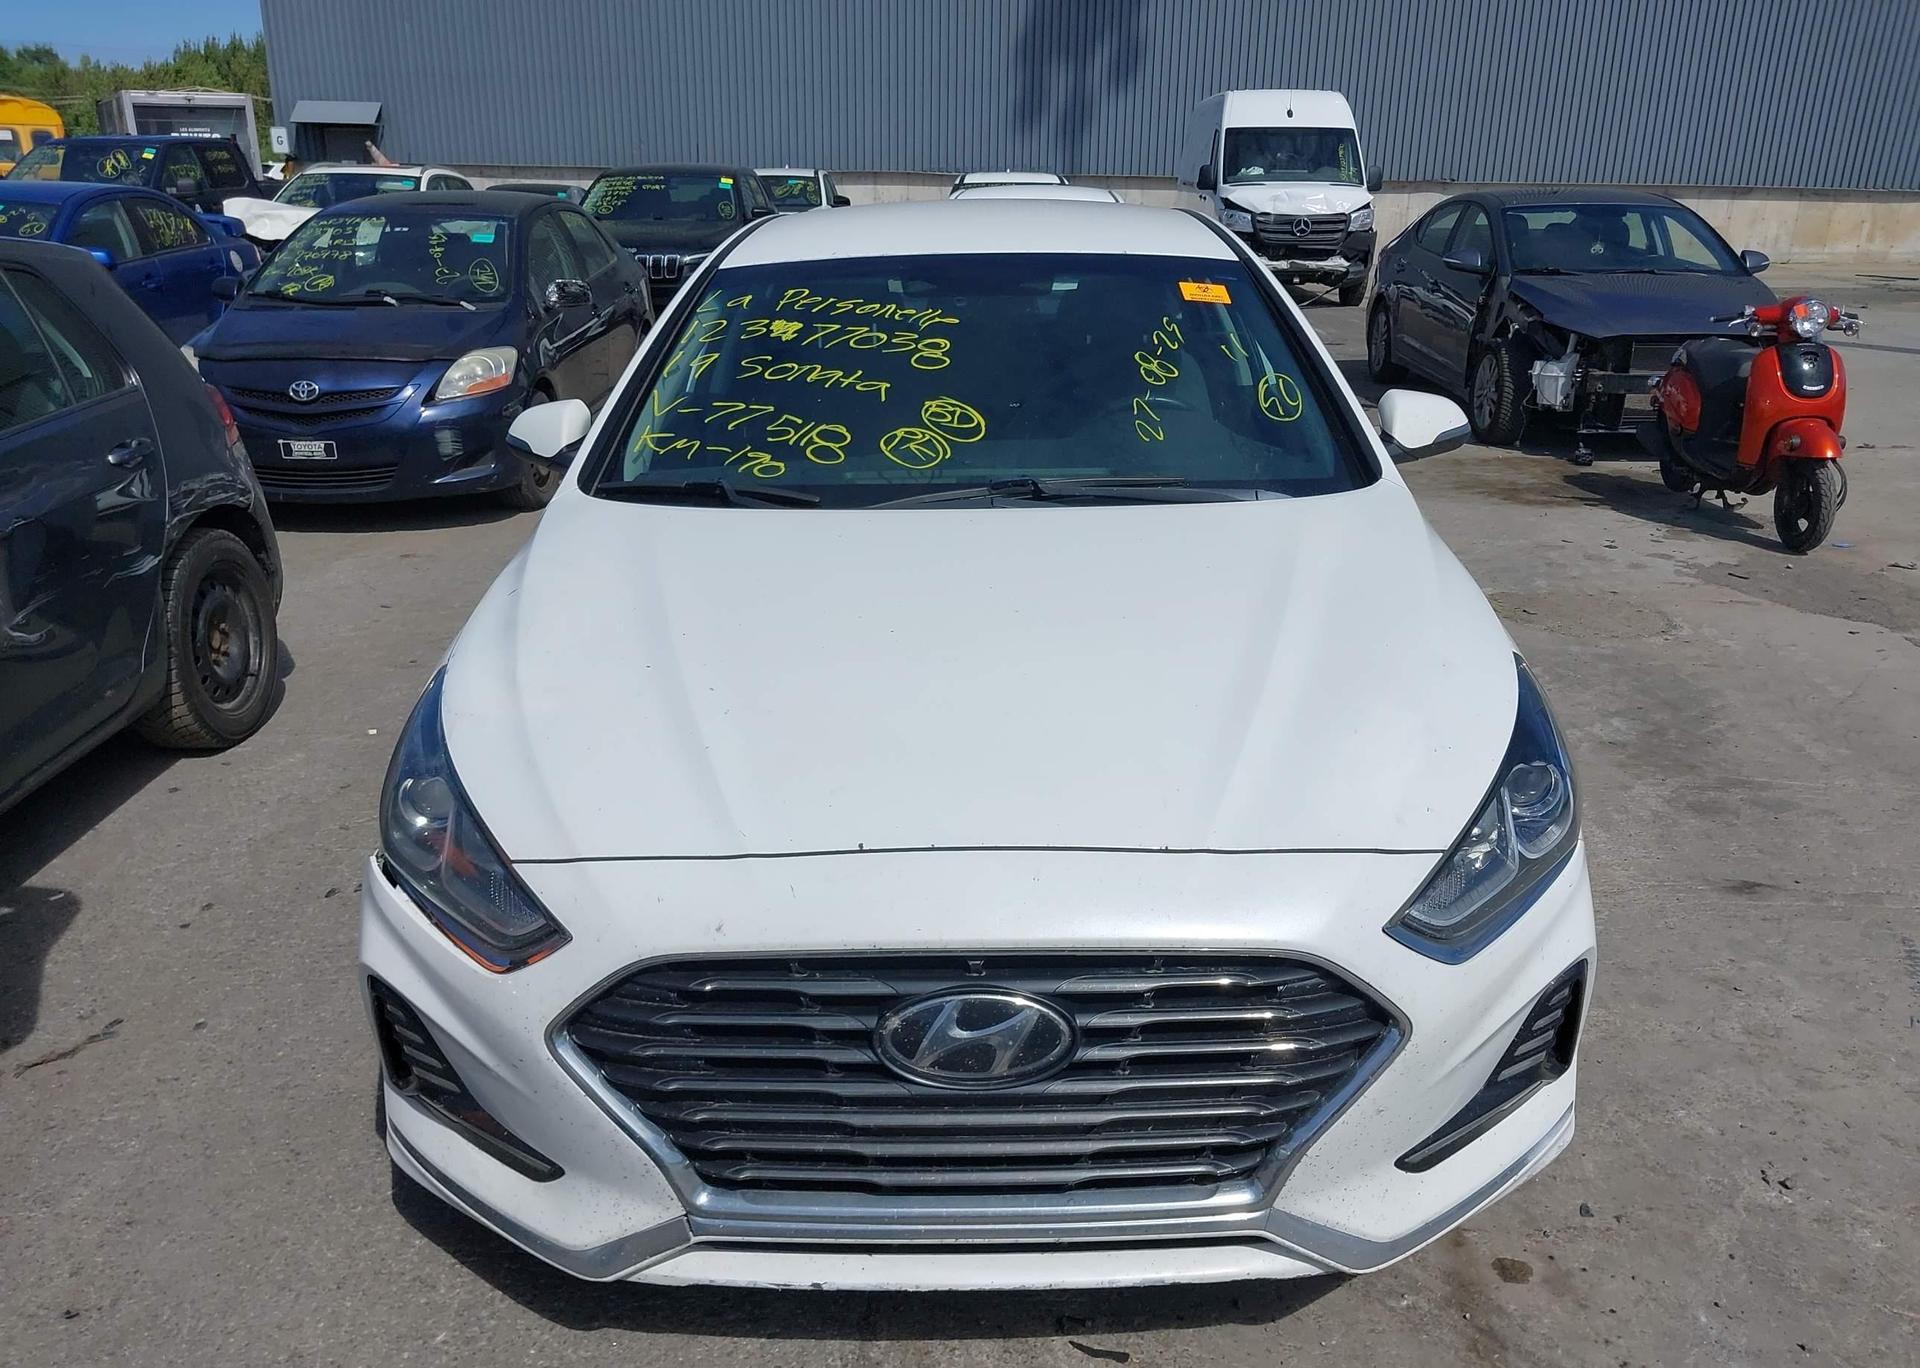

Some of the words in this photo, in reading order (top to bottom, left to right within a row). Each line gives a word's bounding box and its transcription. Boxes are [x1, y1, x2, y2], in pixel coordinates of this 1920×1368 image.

[276, 135, 284, 146] G
[696, 289, 753, 312] La
[292, 442, 323, 451] TOYOTA
